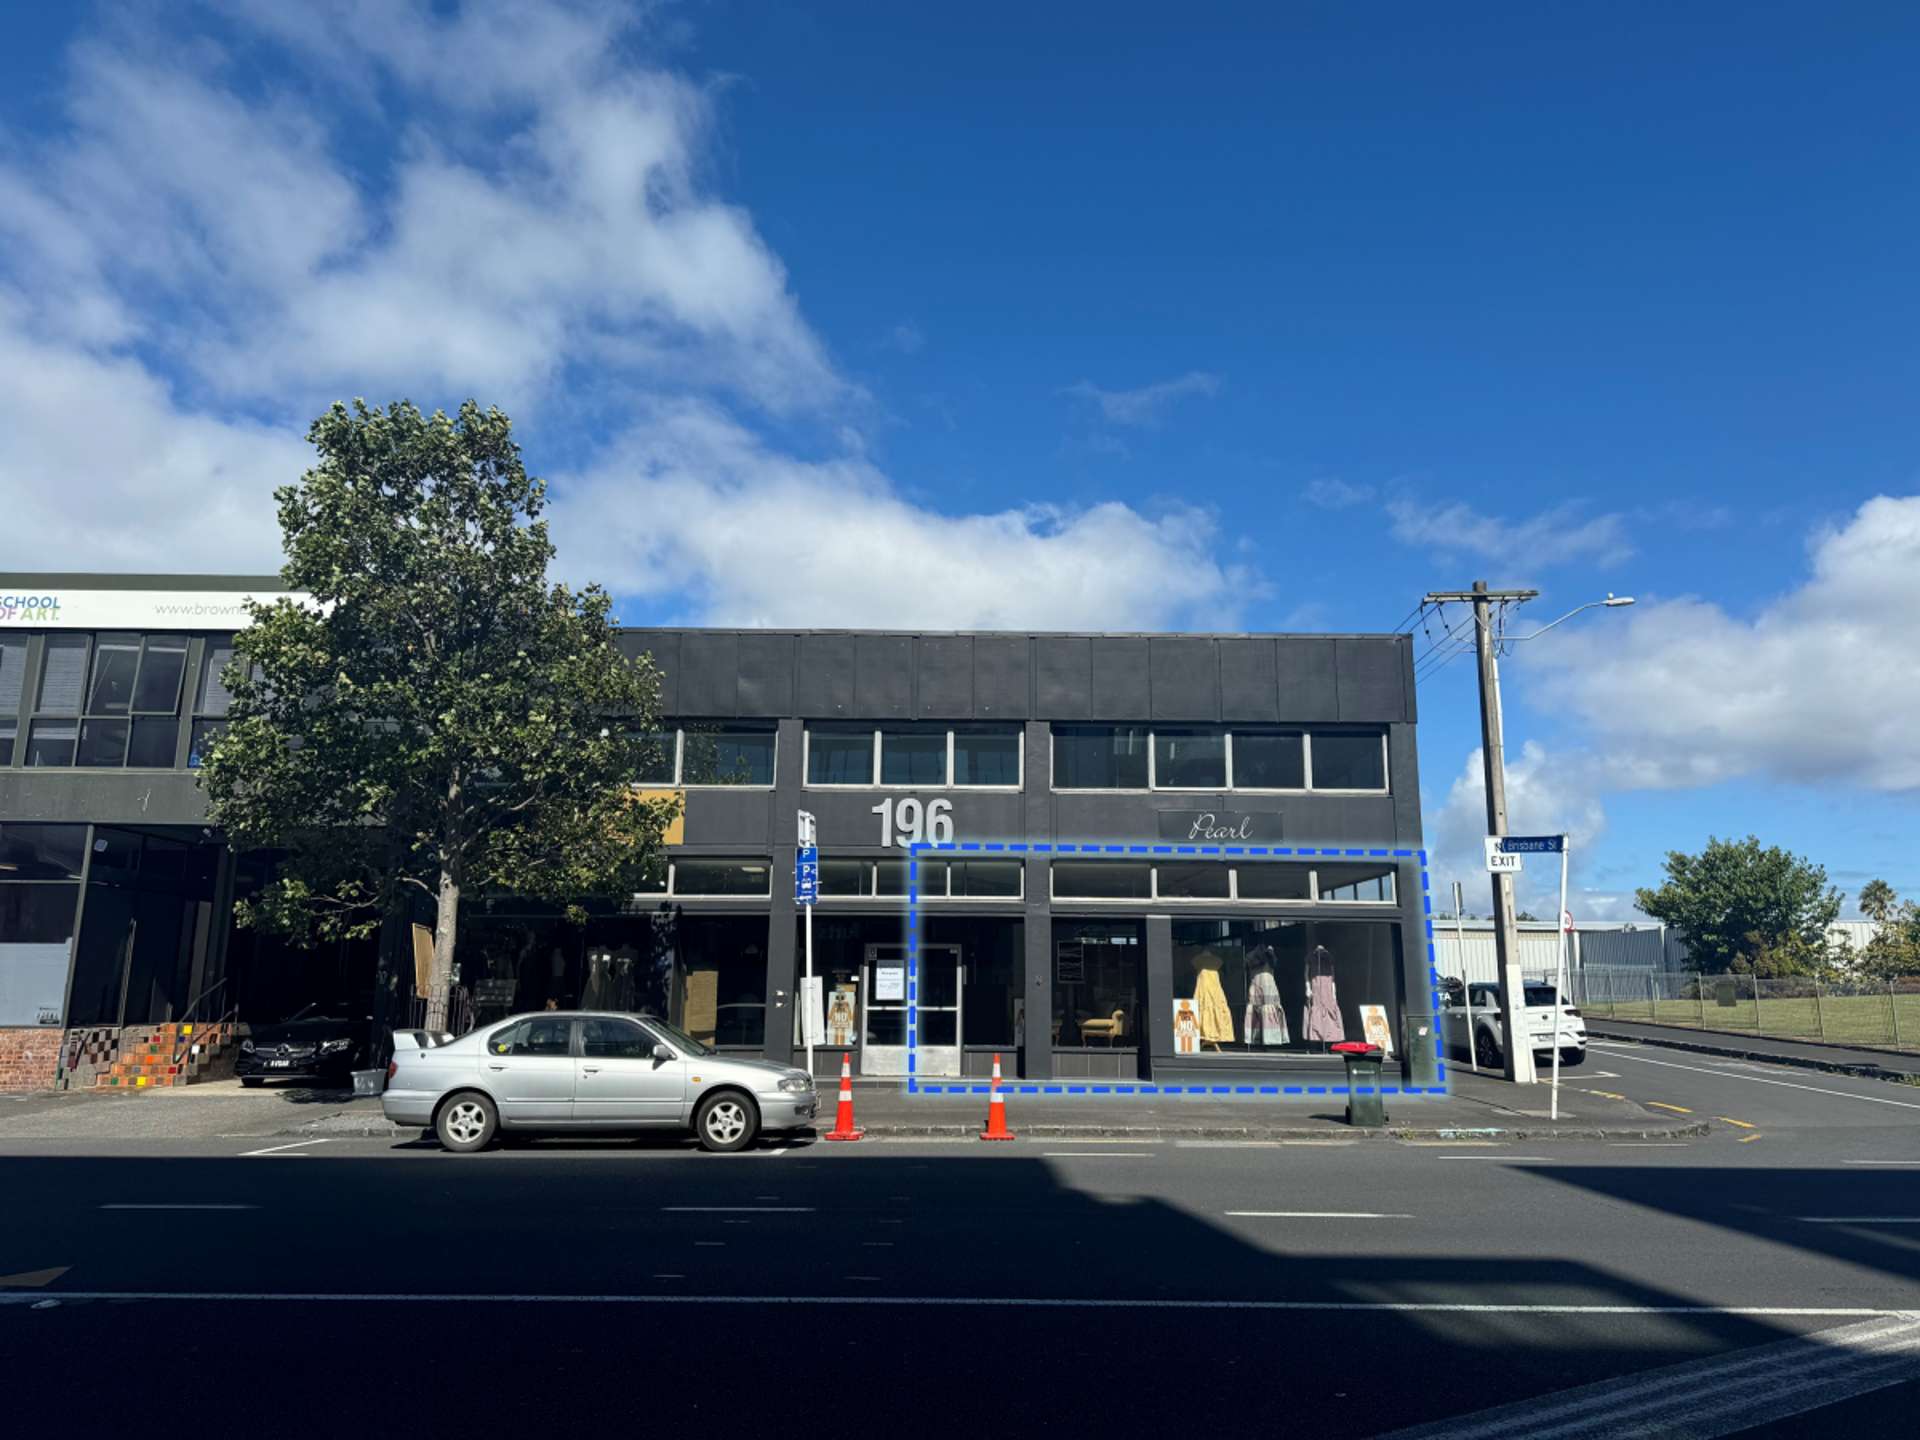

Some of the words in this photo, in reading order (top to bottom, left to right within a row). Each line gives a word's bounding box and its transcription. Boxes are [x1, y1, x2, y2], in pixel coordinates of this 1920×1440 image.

[0, 596, 61, 608] CHOOL
[871, 797, 954, 849] 196
[1187, 813, 1254, 840] Pearl
[1507, 839, 1545, 851] Brisbane
[1491, 855, 1516, 866] EXIT
